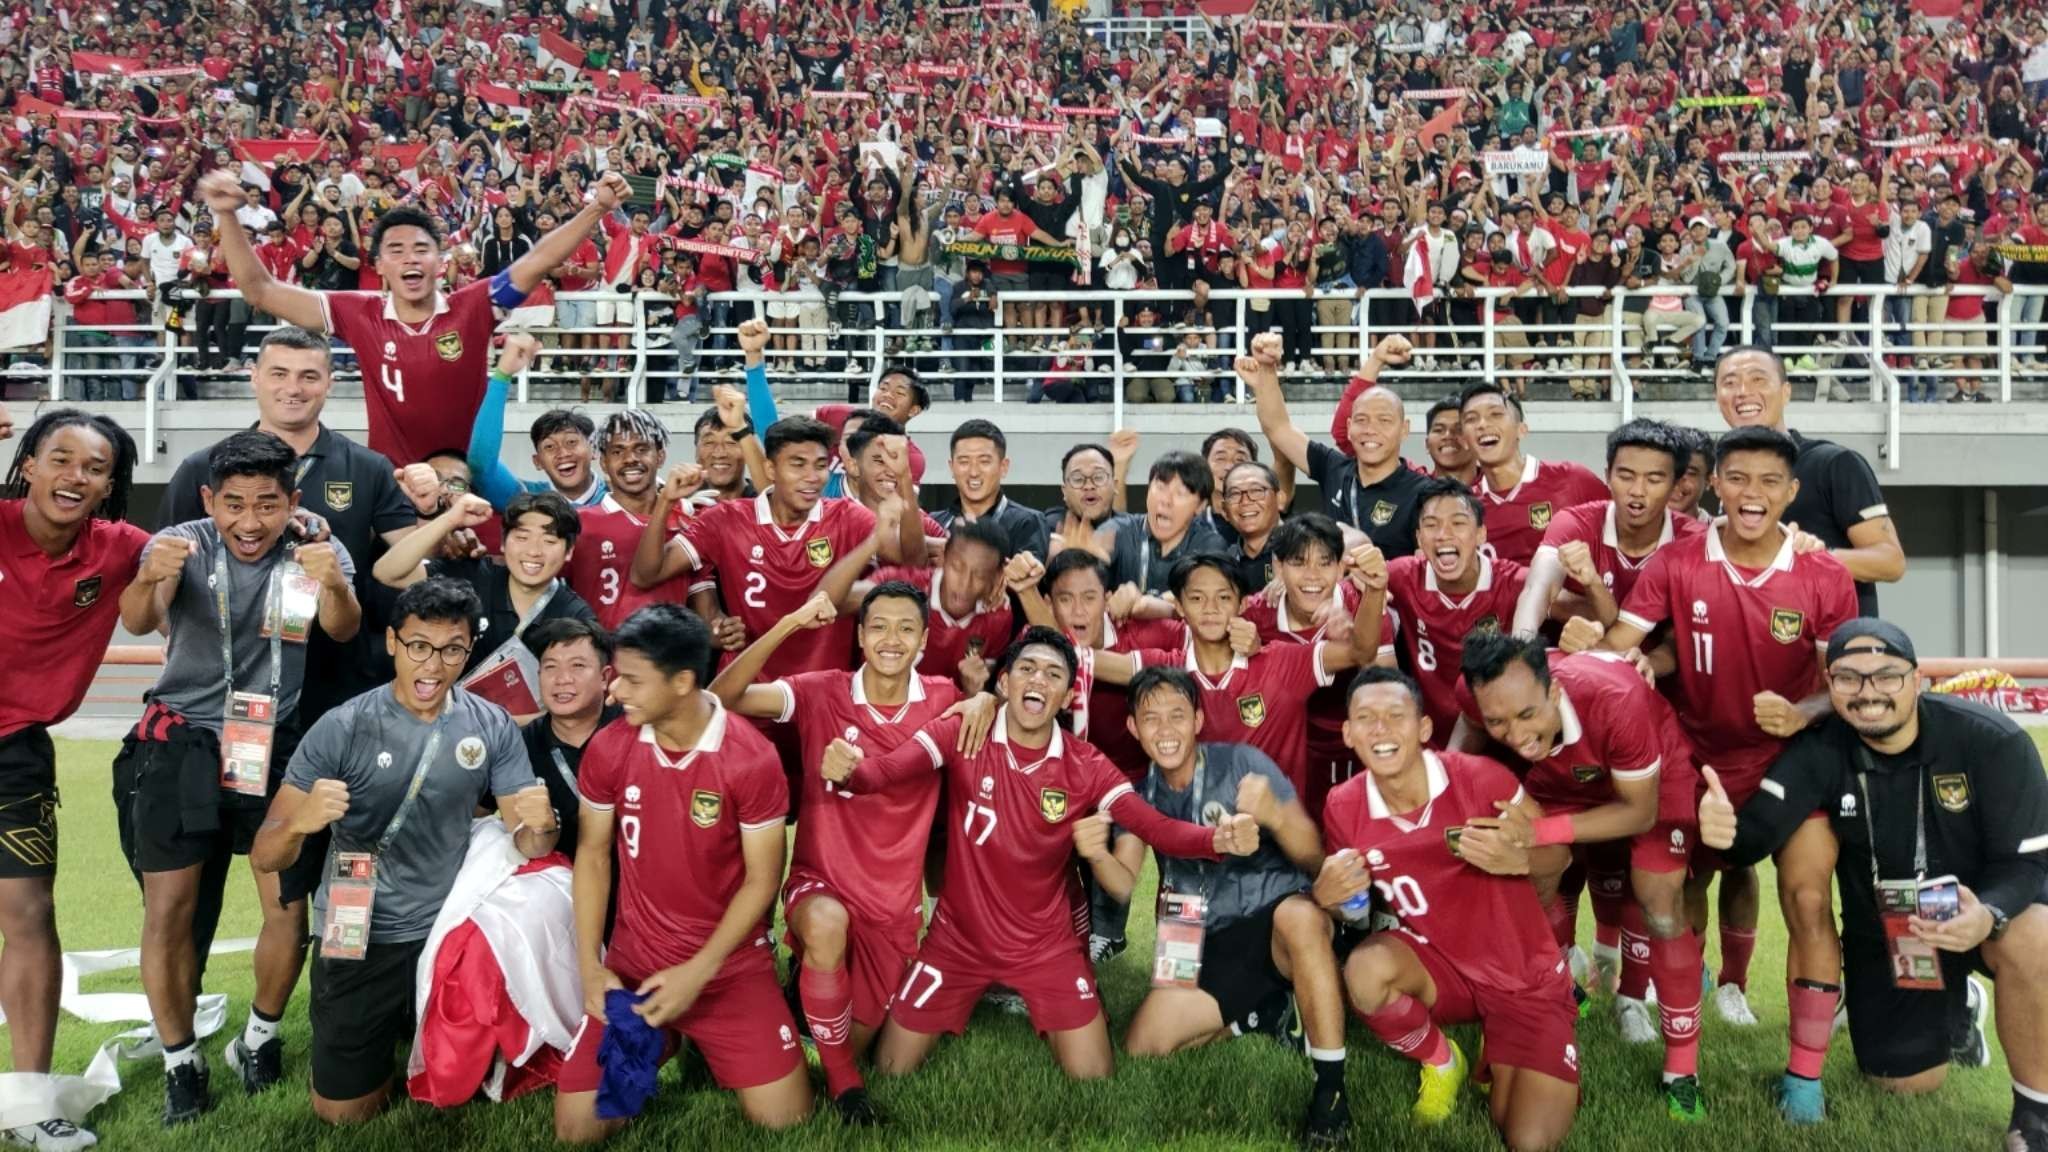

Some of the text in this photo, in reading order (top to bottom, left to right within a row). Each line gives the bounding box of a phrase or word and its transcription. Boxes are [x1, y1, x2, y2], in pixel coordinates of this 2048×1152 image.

[1490, 160, 1544, 171] BARUKAMU
[945, 242, 1077, 259] TRIBUN TIMUR
[382, 364, 404, 402] 4
[600, 568, 620, 605] 3
[744, 571, 767, 608] 2
[1418, 638, 1437, 671] 8
[1691, 631, 1713, 675] 11
[621, 815, 640, 858] 9
[964, 800, 997, 846] 17
[900, 961, 942, 1008] 17
